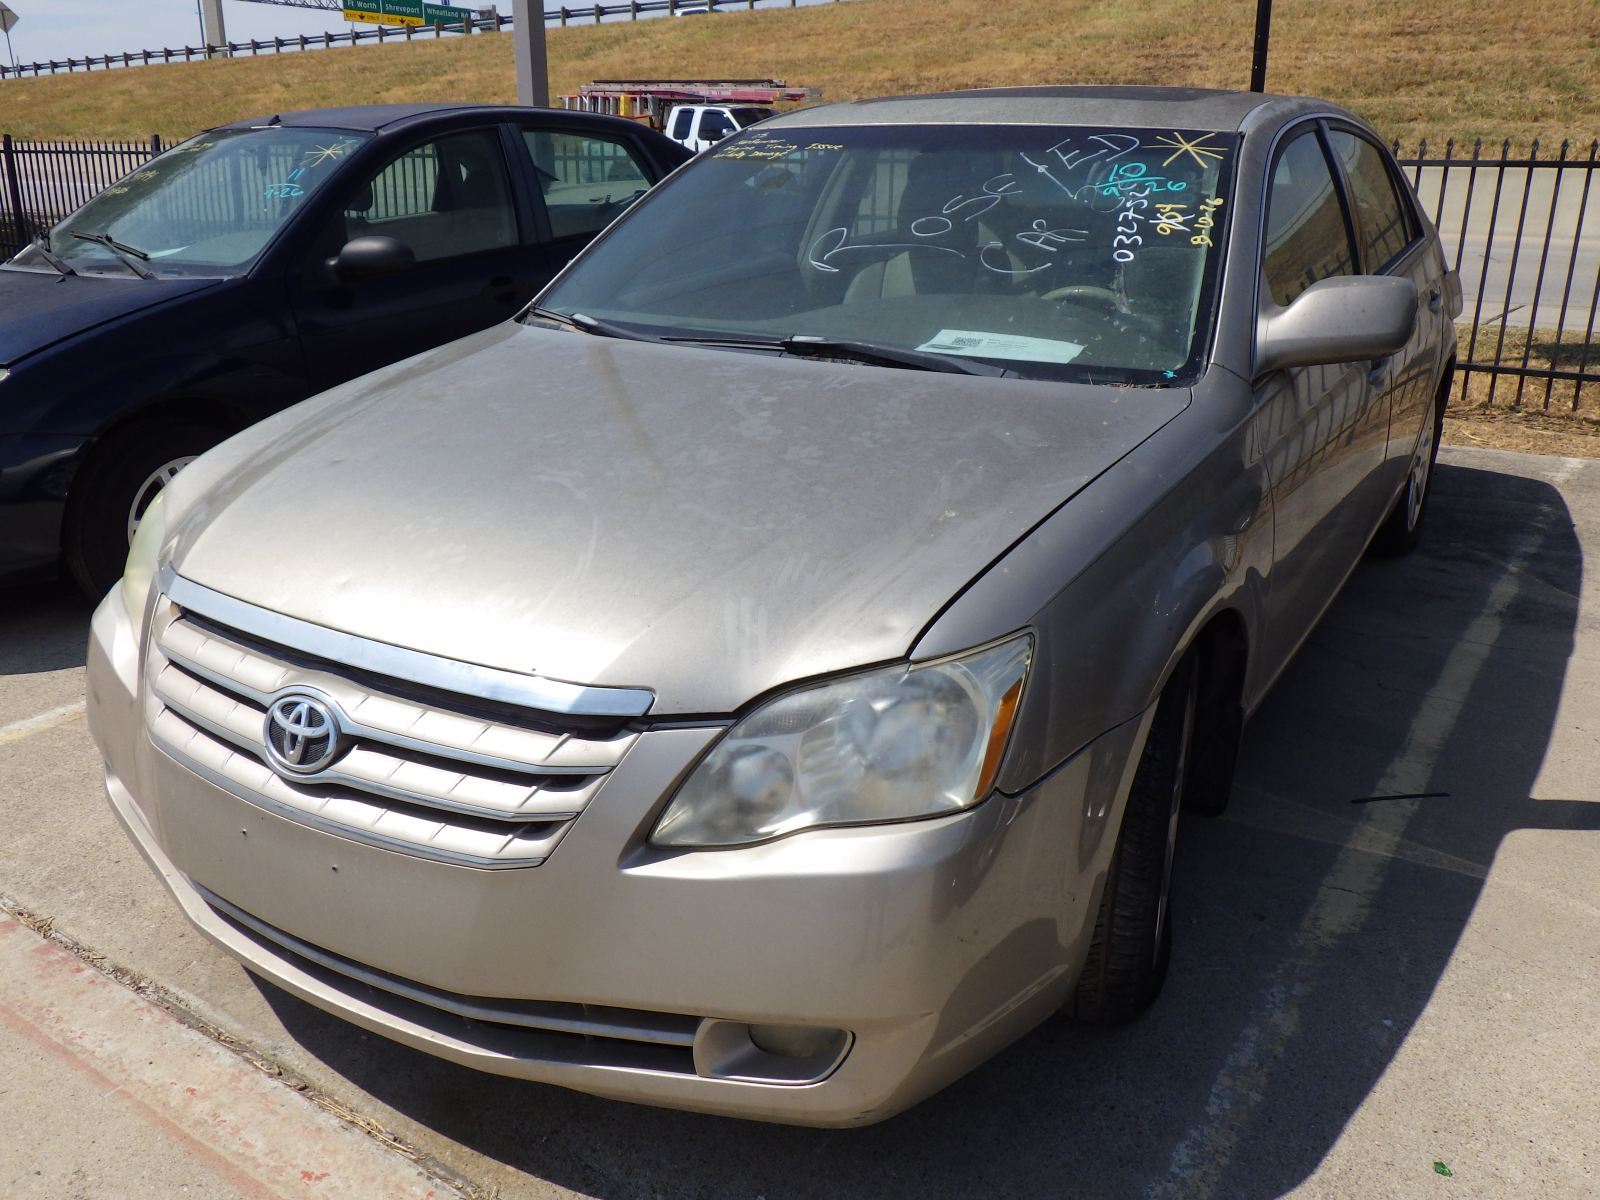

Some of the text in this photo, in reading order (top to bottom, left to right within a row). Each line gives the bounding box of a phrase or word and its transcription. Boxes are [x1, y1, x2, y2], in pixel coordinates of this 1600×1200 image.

[356, 1, 377, 9] Worth
[385, 4, 420, 14] Shreveport
[427, 7, 459, 17] Wheatland
